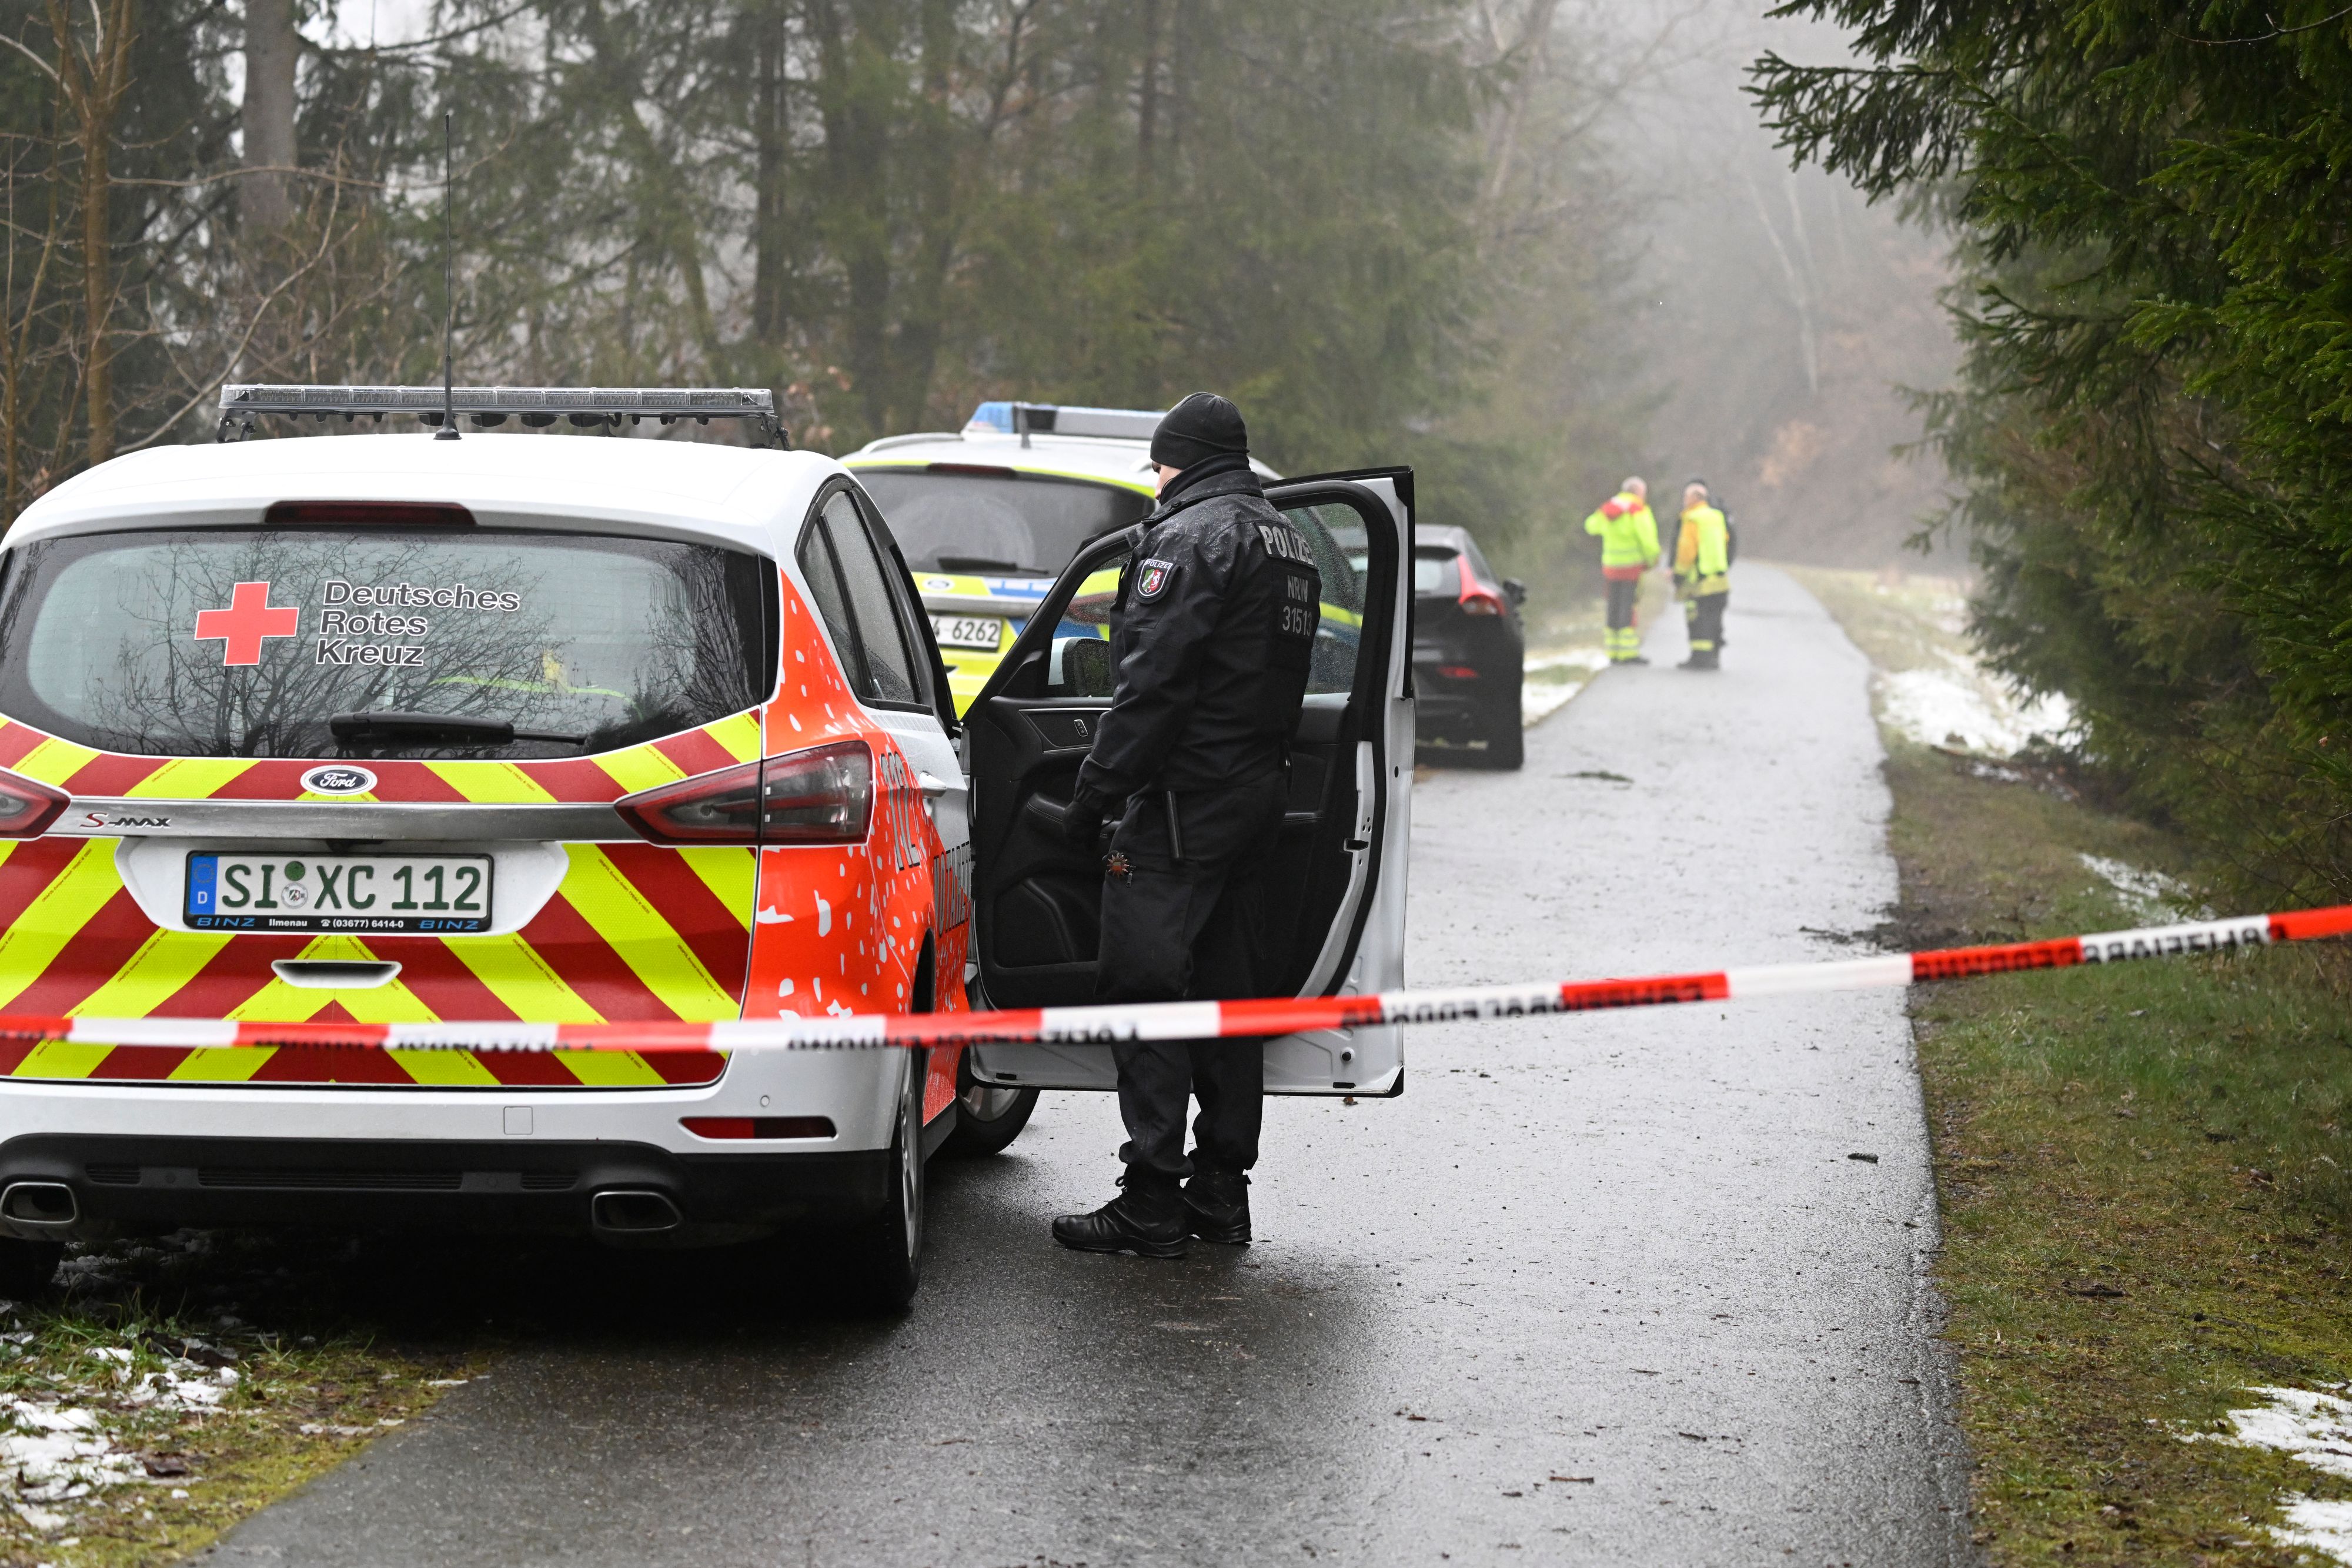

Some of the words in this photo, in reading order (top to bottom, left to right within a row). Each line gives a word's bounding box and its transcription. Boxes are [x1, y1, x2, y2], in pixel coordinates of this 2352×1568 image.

[1258, 525, 1317, 568] POLIZE
[1145, 560, 1171, 570] POLIZEI
[323, 580, 520, 611] Deutsches
[1287, 574, 1308, 603] NRW
[319, 609, 428, 636] Rotes
[952, 620, 1000, 643] 6262
[1282, 605, 1312, 637] 31513
[316, 638, 425, 666] Kreuz
[319, 773, 357, 787] Ford
[79, 813, 171, 829] S-MAX
[197, 891, 208, 905] D
[221, 864, 278, 908] SI
[313, 864, 376, 910] XC
[390, 865, 482, 911] 112
[196, 917, 256, 927] BINZ
[269, 918, 308, 927] Ilmenau
[332, 919, 369, 928] (03677)
[371, 919, 405, 928] 6414-0
[418, 920, 480, 930] BINZ
